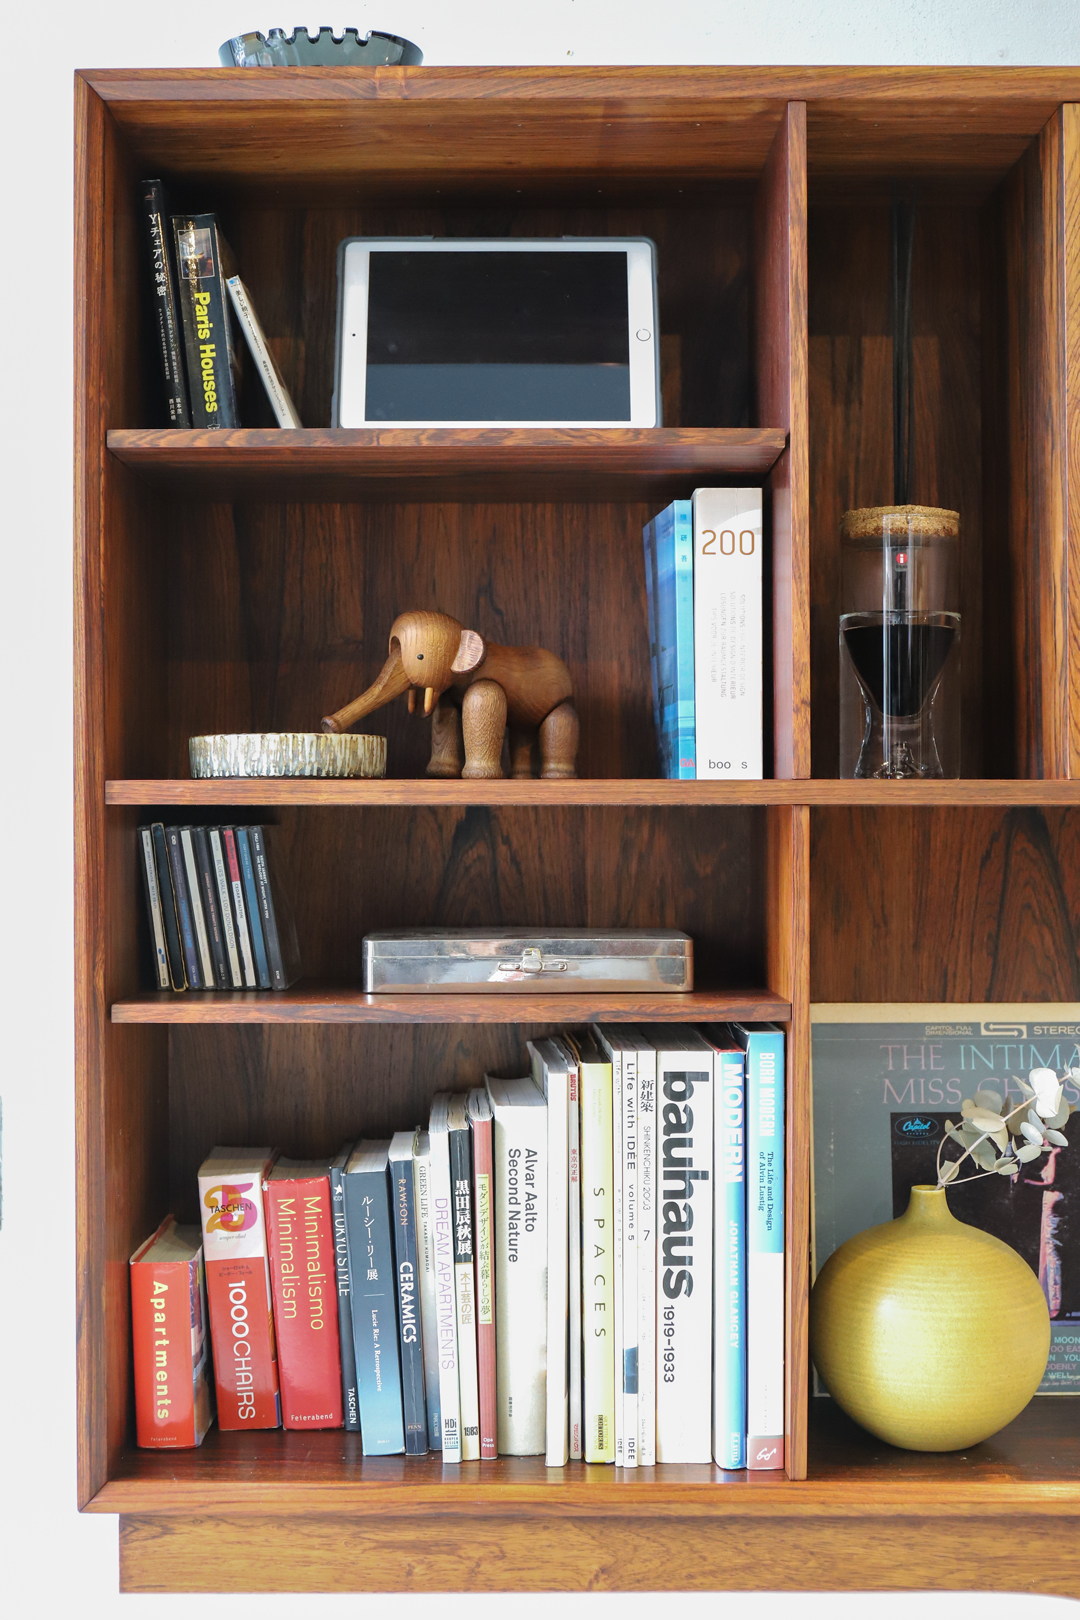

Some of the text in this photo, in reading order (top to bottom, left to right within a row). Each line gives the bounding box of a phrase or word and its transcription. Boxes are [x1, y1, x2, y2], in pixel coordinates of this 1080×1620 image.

[148, 213, 167, 297] Yチェアの秘密
[194, 292, 218, 413] Paris Houses
[702, 530, 755, 555] 200
[709, 759, 748, 769] boos
[219, 878, 227, 894] WALK
[224, 913, 235, 949] DONALDSON
[626, 1063, 636, 1090] Life
[880, 1044, 945, 1071] THE
[627, 1098, 636, 1128] with
[640, 1080, 654, 1112] 新建築
[759, 1052, 775, 1137] BORN MODERN
[882, 1078, 962, 1105] MISS
[723, 1063, 743, 1183] MODERN
[903, 1118, 931, 1132] Capitol
[627, 1136, 637, 1170] IDÉE
[758, 1152, 766, 1161] of
[398, 1178, 408, 1226] RAWSON
[419, 1165, 428, 1196] GREEN
[525, 1148, 538, 1233] Alvar Aalto
[643, 1125, 651, 1241] SHINKENCHIKU 2003 7
[758, 1185, 766, 1211] Lustig
[209, 1203, 252, 1213] TASCHEN
[420, 1198, 429, 1218] LIFE
[455, 1179, 472, 1256] 黒田辰秋展
[508, 1148, 521, 1263] Second Nature
[628, 1184, 636, 1229] volume
[662, 1071, 709, 1383] bauhaus 1919-1933
[766, 1203, 774, 1231] Design
[277, 1198, 300, 1319] Minimalism
[361, 1196, 379, 1281] ルーシー・リー展
[478, 1183, 491, 1316] モダンデザインが結ぶ暮らしの夢
[304, 1196, 326, 1330] Minimalismo
[435, 1198, 455, 1370] DREAM APARTMENTS
[593, 1187, 606, 1338] SPACES
[729, 1219, 738, 1349] JONATHAN GLANCEY
[400, 1261, 417, 1344] CERAMICS
[460, 1271, 472, 1325] 木工芸の匠
[150, 1281, 171, 1420] Apartments
[228, 1280, 256, 1419] 1000 CHAIRS
[374, 1350, 383, 1392] Retrospective
[291, 1413, 333, 1422] Feierabend
[348, 1387, 357, 1424] TASCHEN
[444, 1418, 457, 1429] HDi
[463, 1426, 479, 1437] 1983
[628, 1437, 636, 1460] IDÉE
